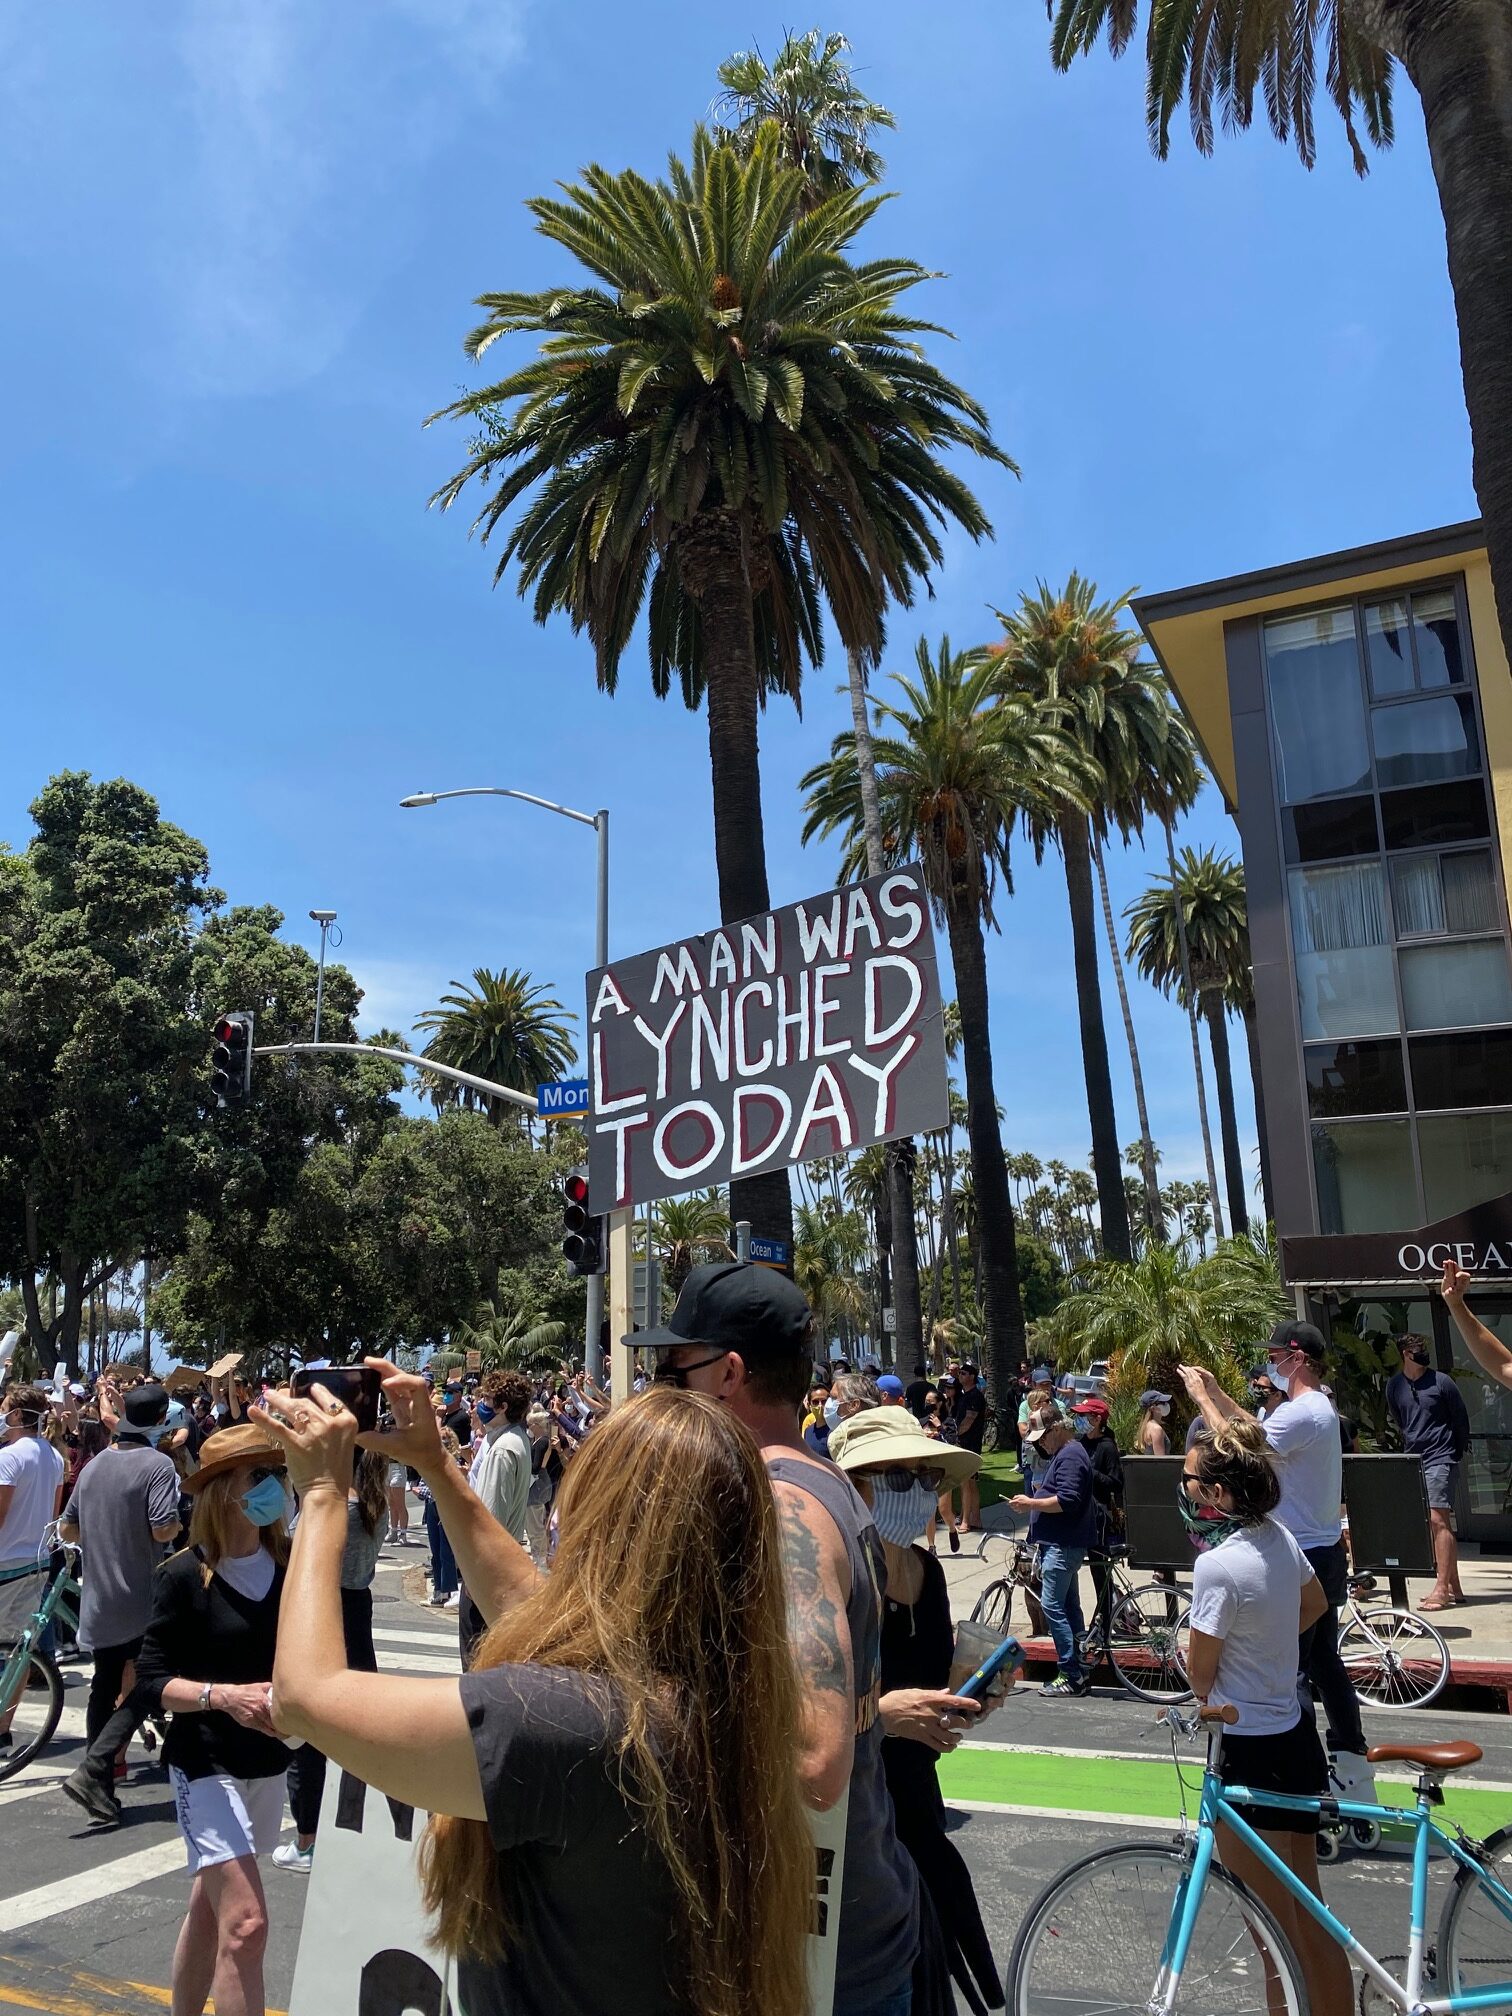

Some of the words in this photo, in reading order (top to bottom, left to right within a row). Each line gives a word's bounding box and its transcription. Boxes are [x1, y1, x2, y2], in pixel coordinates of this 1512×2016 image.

[591, 975, 631, 1023] A
[650, 915, 777, 1004] MAN
[795, 874, 924, 964] WAS
[593, 954, 923, 1116] LYNCHED
[595, 1034, 917, 1203] TODAY
[750, 1241, 772, 1258] Ocean
[1398, 1242, 1512, 1272] OCEA
